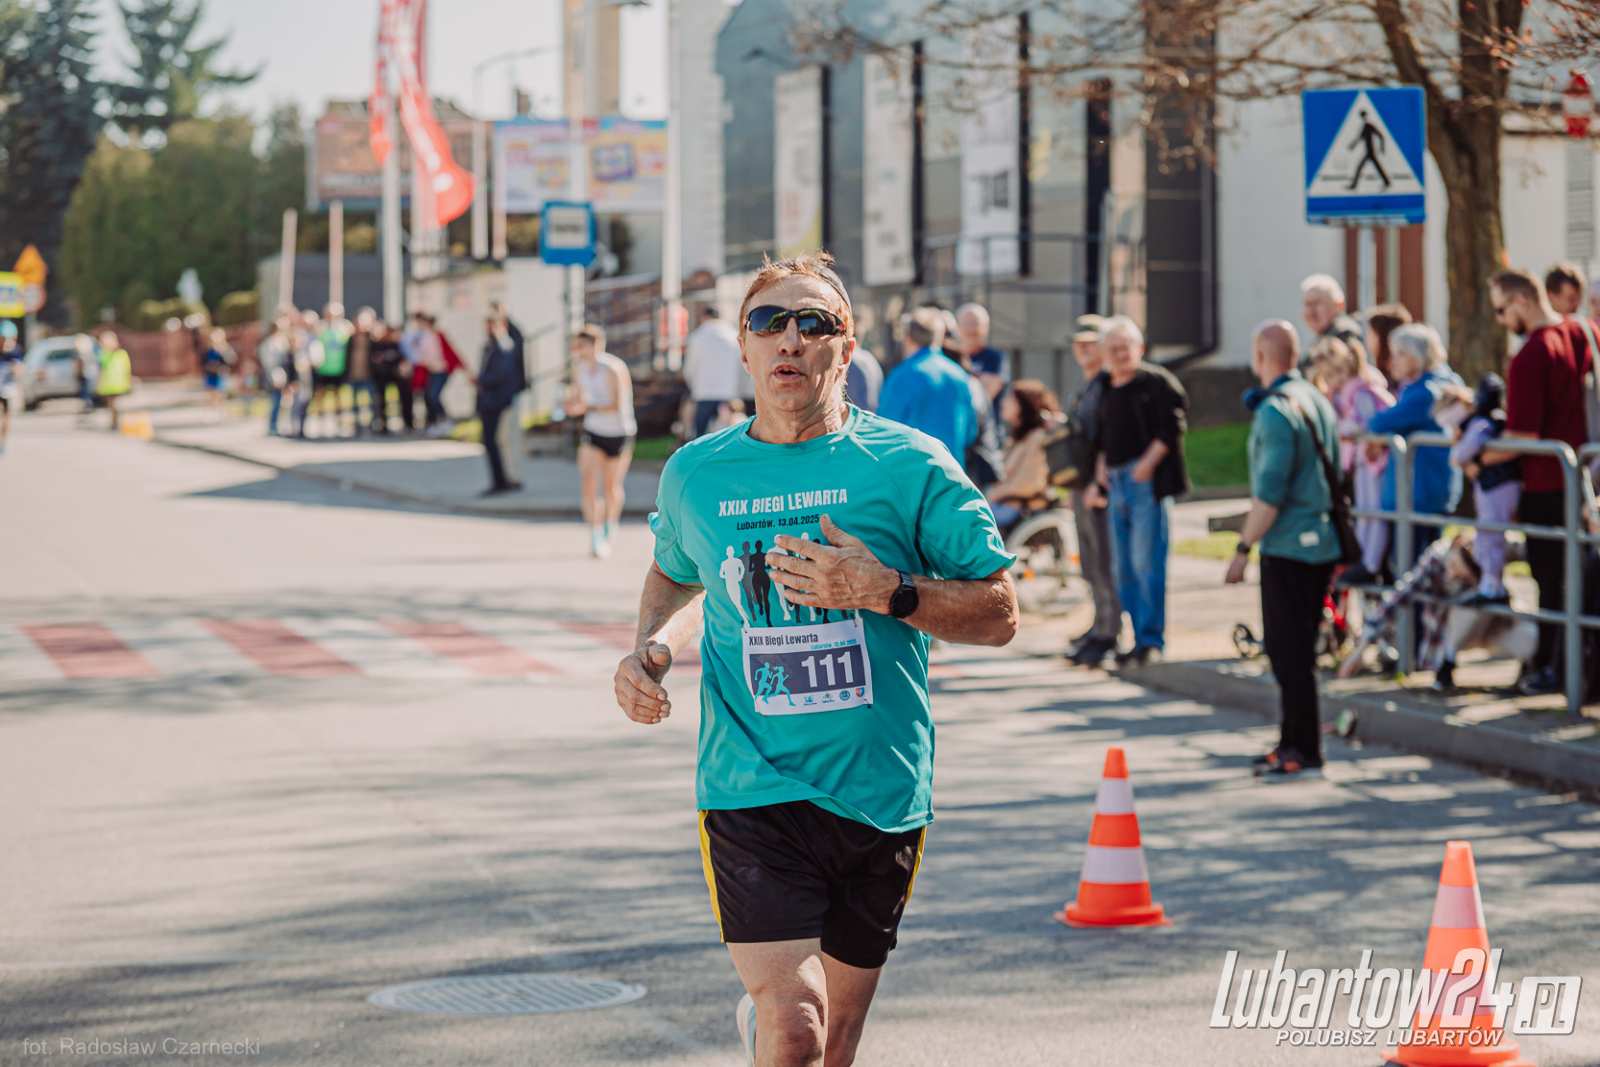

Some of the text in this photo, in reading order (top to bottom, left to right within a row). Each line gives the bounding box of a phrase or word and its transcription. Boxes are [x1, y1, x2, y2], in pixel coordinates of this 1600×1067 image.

[718, 488, 848, 517] XXIX BIEGI LEWARTA
[749, 636, 764, 646] XXIX
[765, 634, 784, 646] Biegi
[785, 633, 819, 645] Lewarta
[801, 651, 854, 688] 111
